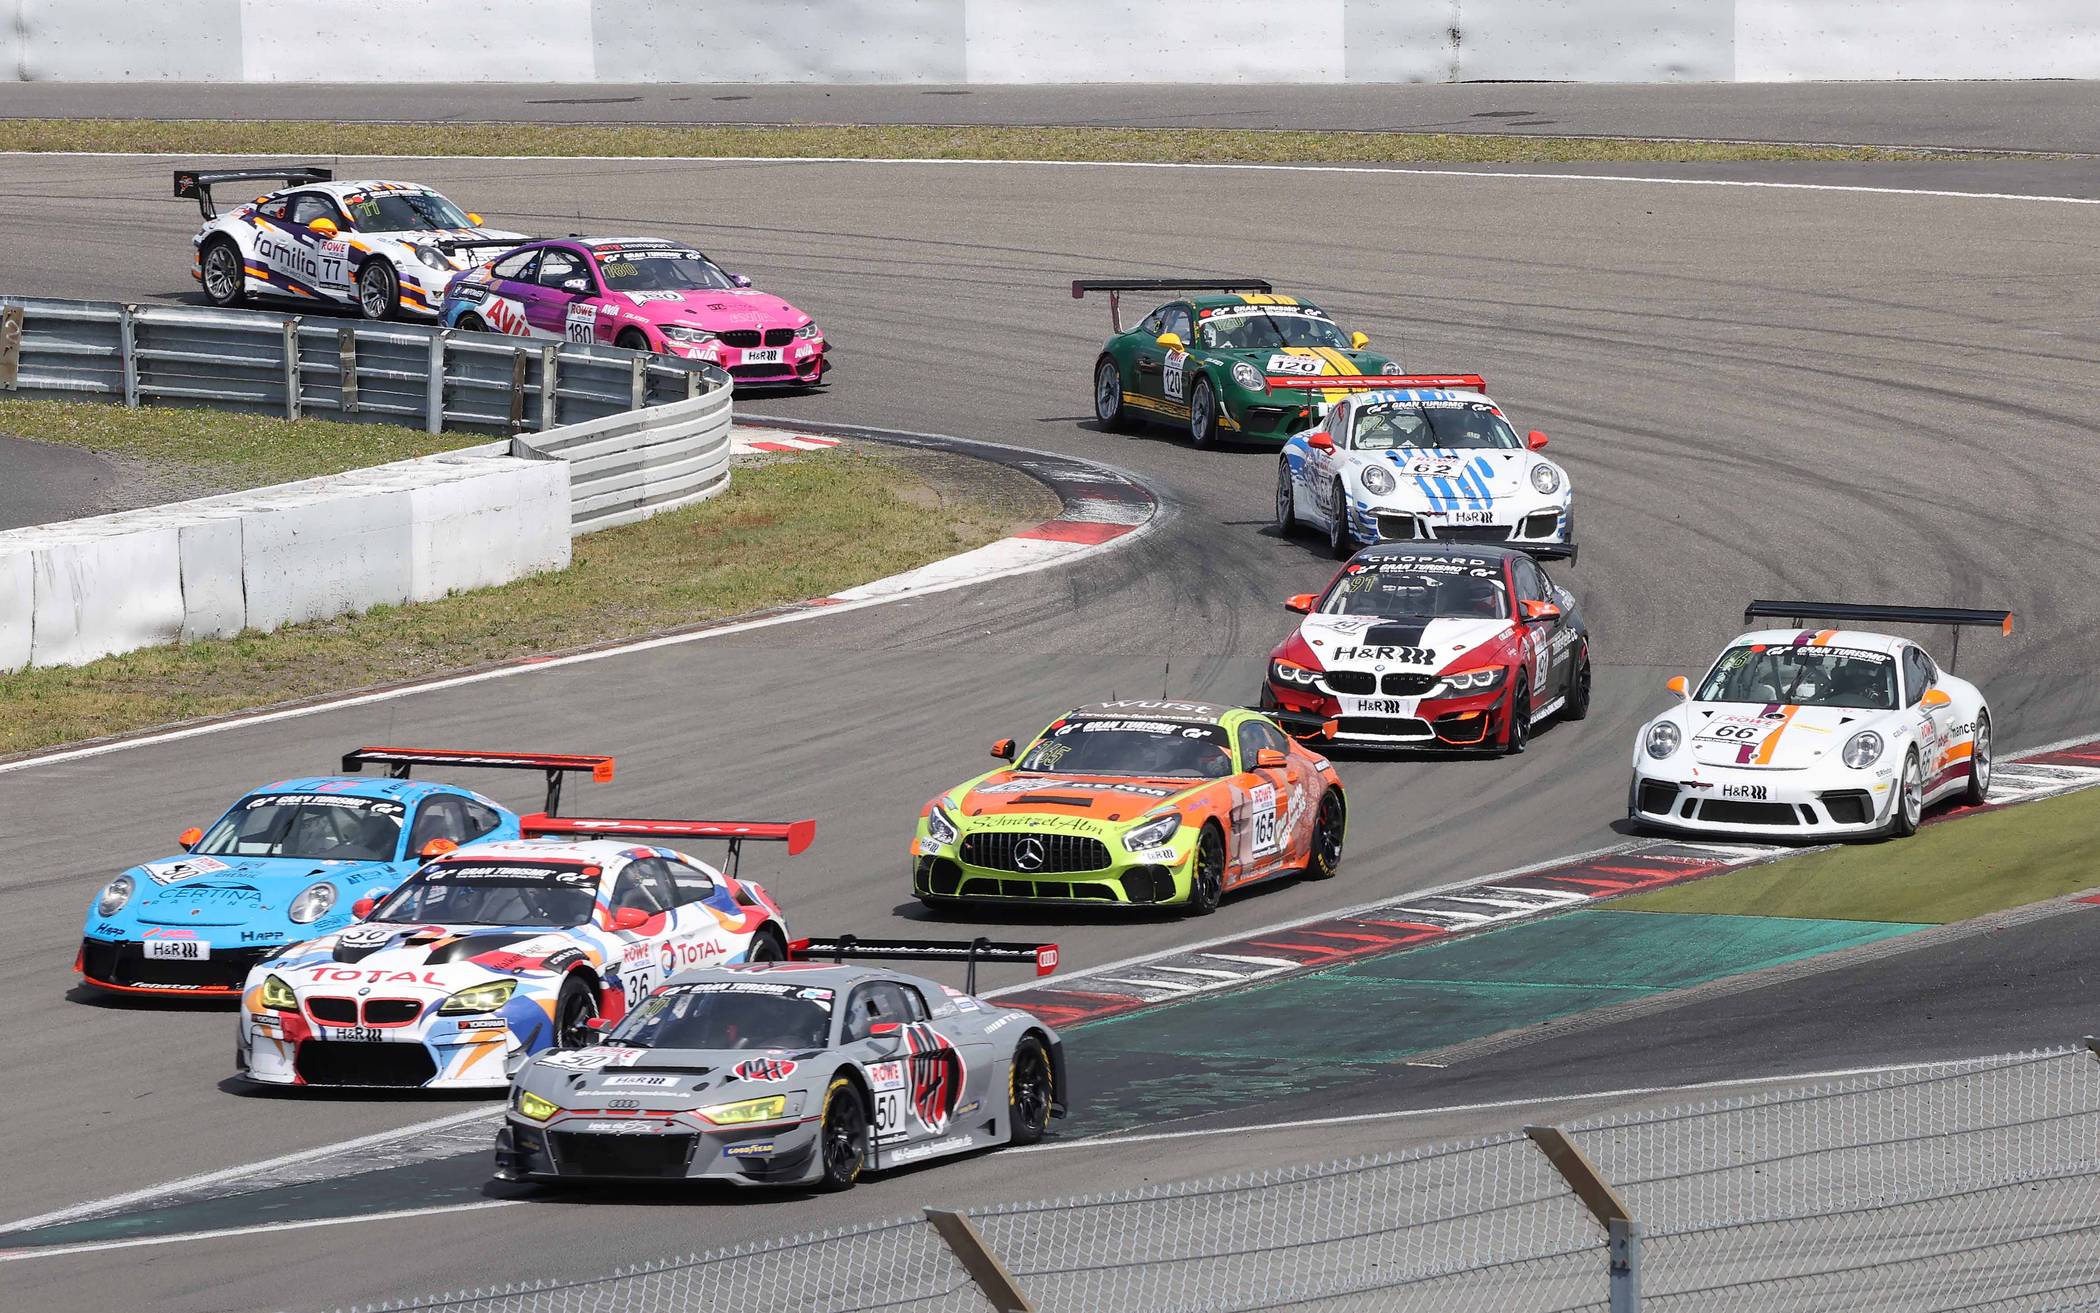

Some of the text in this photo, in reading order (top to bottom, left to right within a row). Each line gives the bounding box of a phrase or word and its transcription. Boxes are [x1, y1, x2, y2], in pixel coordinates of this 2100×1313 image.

[356, 200, 381, 217] 77
[321, 241, 346, 253] ROWE
[254, 231, 317, 278] familia
[322, 258, 342, 281] 77
[602, 262, 639, 279] 180
[570, 303, 593, 317] ROWE
[601, 303, 620, 316] AVIA
[1233, 305, 1259, 313] GRAN
[568, 323, 592, 344] 180
[687, 348, 718, 361] AVIA
[748, 351, 766, 361] H&R
[794, 343, 815, 359] AVIA
[1273, 360, 1316, 372] 120
[1165, 368, 1182, 395] 120
[1391, 400, 1465, 410] GRAN TURISMO
[1413, 463, 1452, 474] 62
[1456, 512, 1479, 524] H&R
[1368, 555, 1486, 566] CHOPARD
[1379, 563, 1413, 571] GRAN
[1412, 564, 1464, 573] TURISMO
[1333, 646, 1396, 661] H&R
[1796, 646, 1833, 656] GRAN
[1832, 648, 1888, 662] TURISMO
[1102, 699, 1212, 715] Wurst
[1358, 699, 1383, 711] H&R
[1082, 721, 1119, 731] GRAN
[1118, 721, 1180, 733] TURISMO
[1725, 715, 1780, 726] ROWE
[1714, 725, 1759, 739] 66
[1071, 782, 1167, 797] REHM
[1253, 786, 1273, 802] ROWE
[1722, 784, 1750, 798] H&R
[276, 795, 312, 804] GRAN
[311, 795, 368, 807] TURISMO
[966, 815, 1104, 836] Schnitzel-Alm
[1254, 812, 1274, 845] 165
[457, 867, 551, 877] GRAN TURISMO
[158, 888, 262, 902] CERTINA
[152, 942, 181, 957] H&R
[623, 943, 649, 963] ROWE
[677, 938, 727, 965] TOTAL
[309, 967, 446, 987] TOTAL
[628, 972, 649, 1008] 36
[691, 982, 791, 993] GRAN TURISMO
[468, 1019, 506, 1029] YOKOHAMA
[335, 1028, 367, 1041] H&R
[872, 1063, 899, 1082] ROWE
[875, 1094, 897, 1131] 50
[727, 1143, 774, 1155] GOODYEAR
